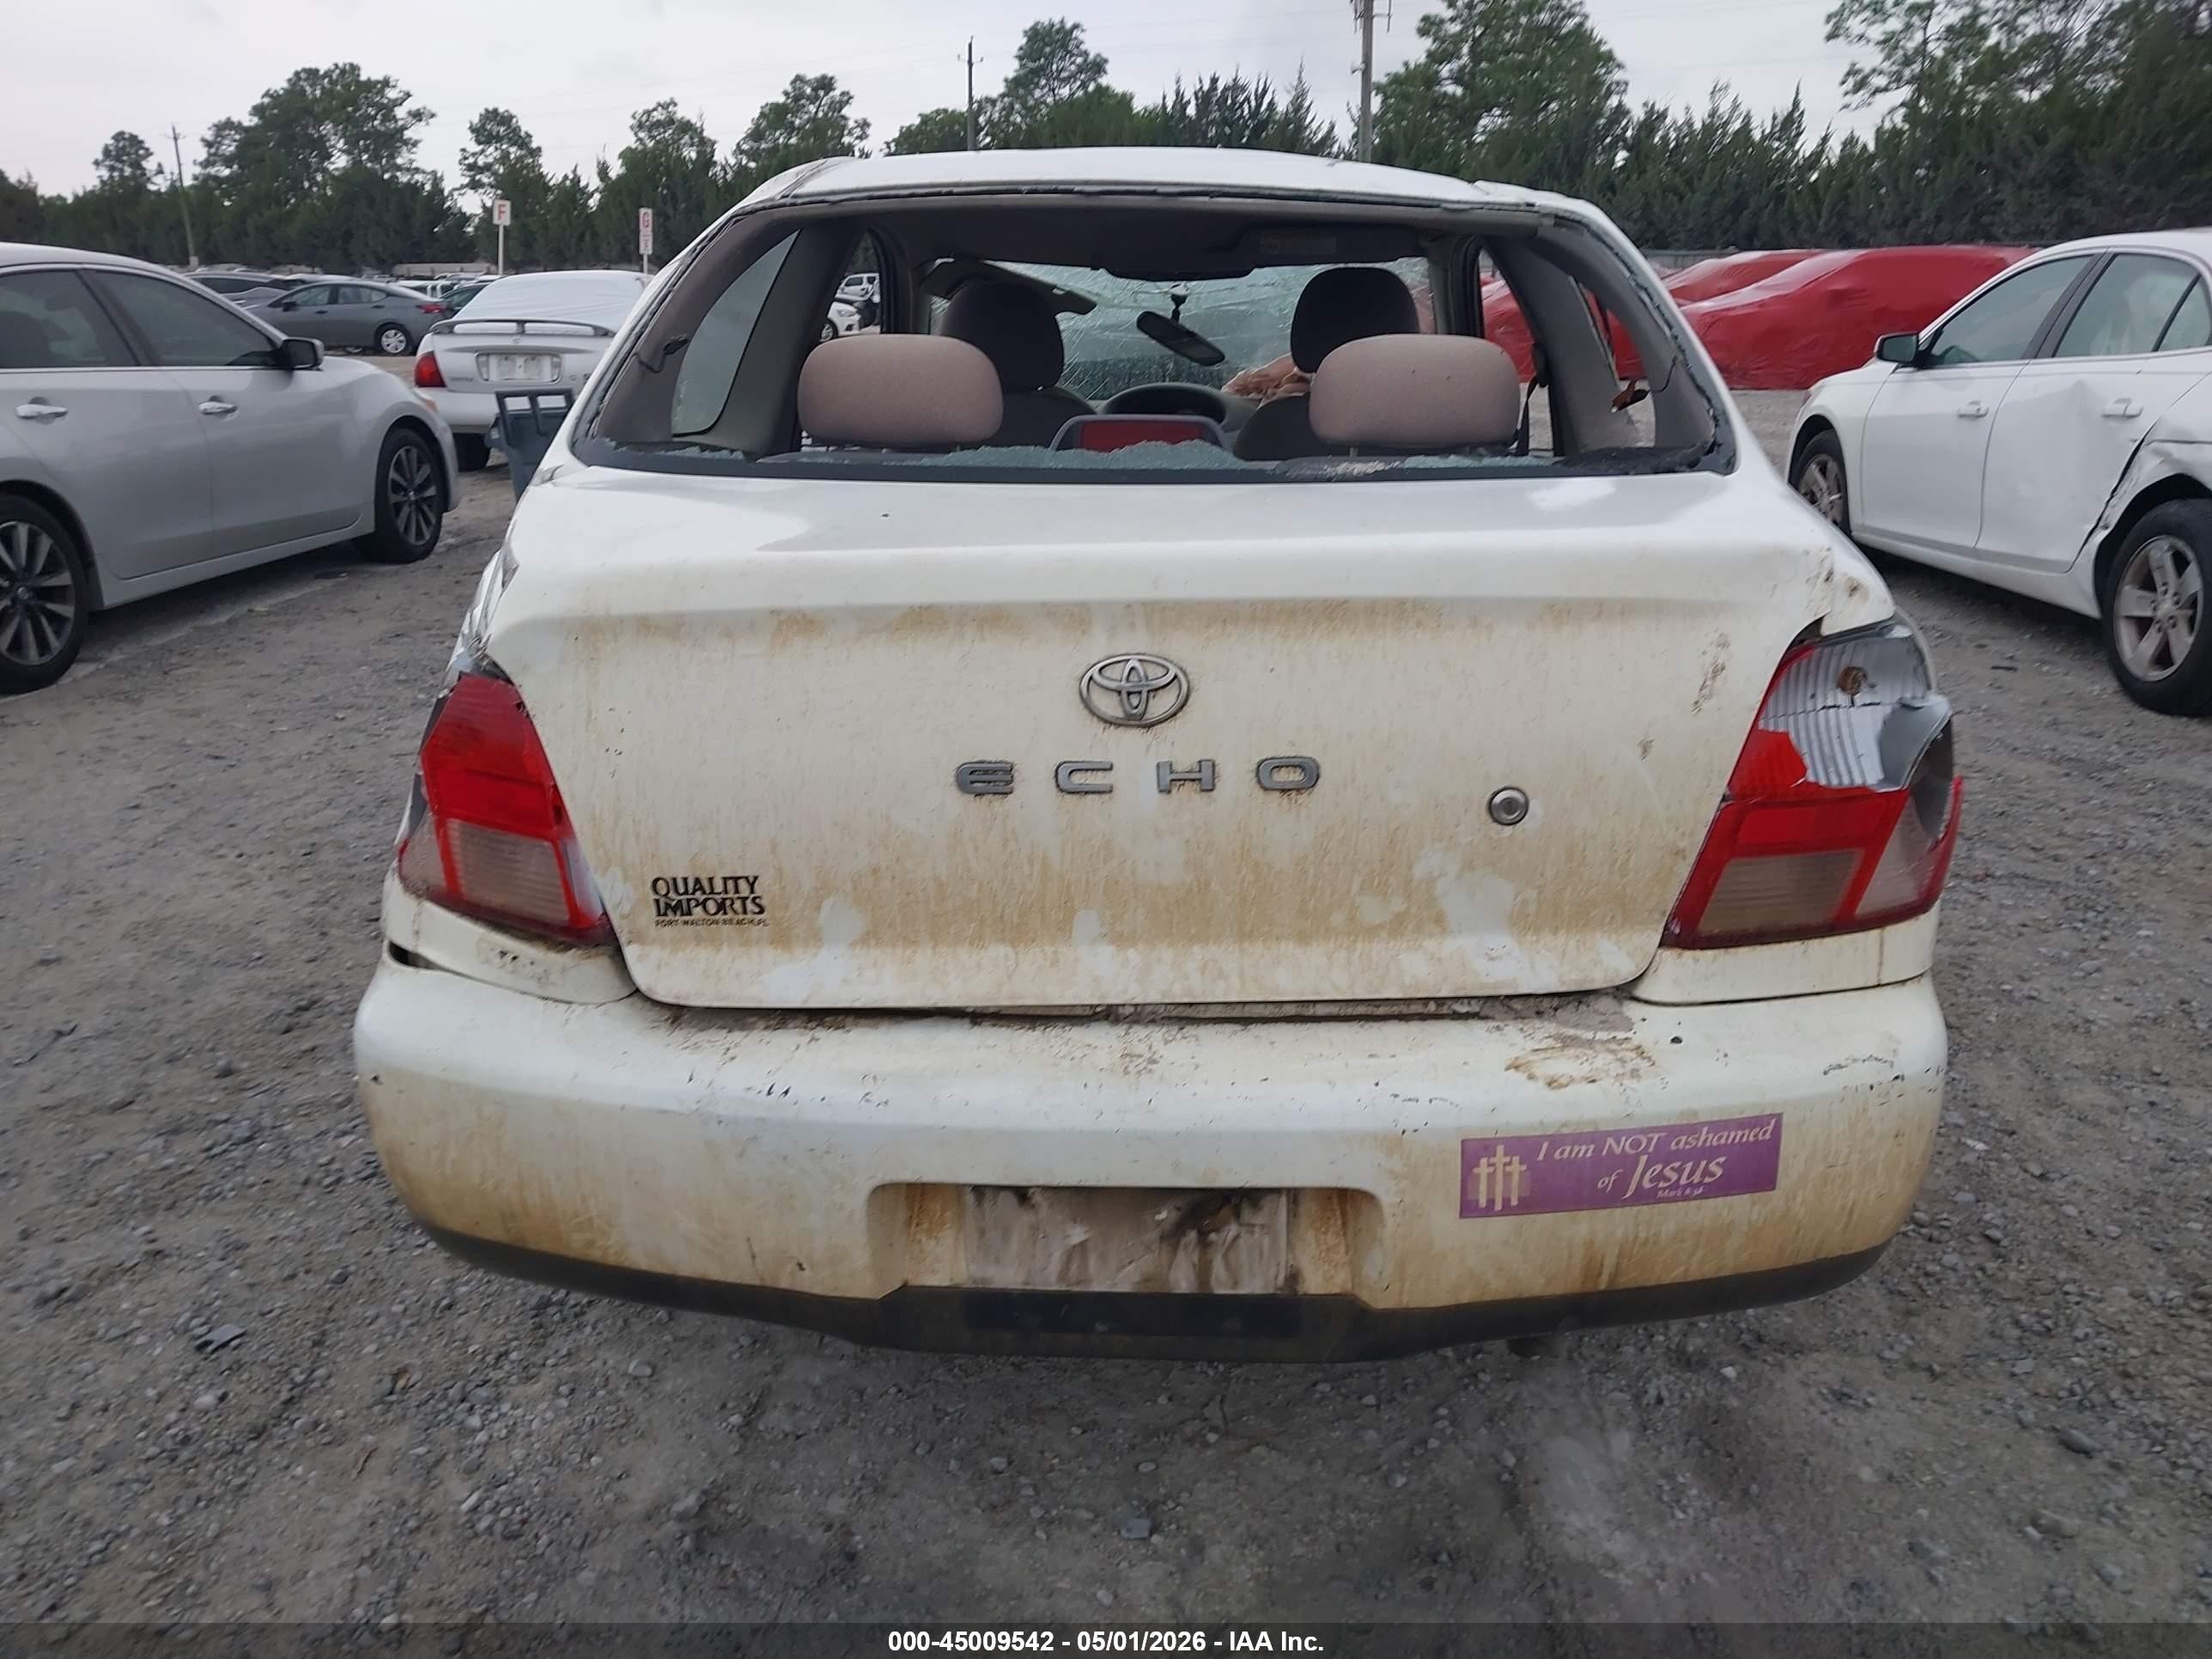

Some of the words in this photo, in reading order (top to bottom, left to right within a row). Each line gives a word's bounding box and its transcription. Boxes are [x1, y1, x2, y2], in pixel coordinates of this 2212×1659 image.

[497, 204, 506, 221] F
[955, 757, 1320, 794] ECHO
[651, 875, 759, 898] QUALITY
[653, 896, 766, 918] IMPORTS
[1536, 1140, 1549, 1161] I
[1554, 1144, 1595, 1159] am
[1602, 1133, 1668, 1156] NOT
[1670, 1118, 1777, 1151] ashamed
[1597, 1169, 1623, 1192] of
[1622, 1155, 1727, 1200] Jesus
